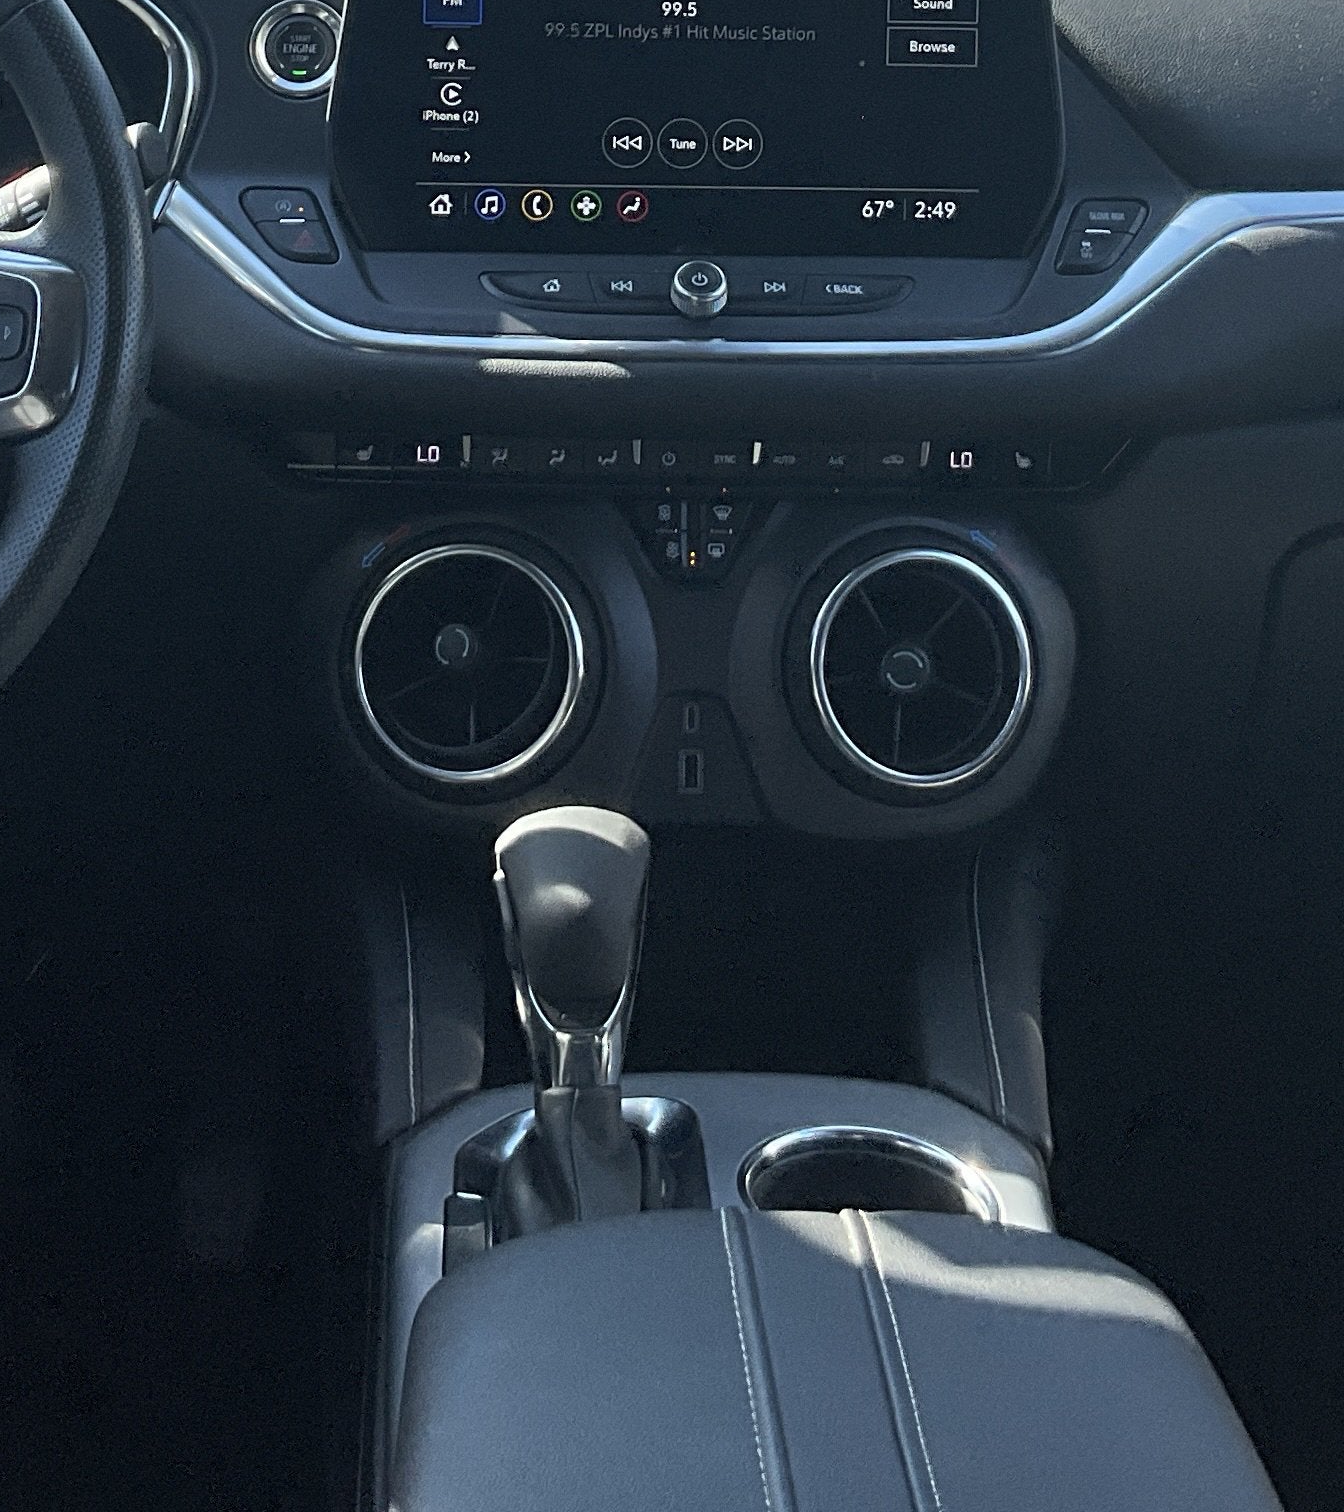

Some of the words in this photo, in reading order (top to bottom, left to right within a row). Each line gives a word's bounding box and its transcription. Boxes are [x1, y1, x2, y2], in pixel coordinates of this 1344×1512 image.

[661, 2, 698, 17] 99.5
[545, 23, 580, 38] 99.5
[584, 23, 615, 39] ZPL
[618, 24, 658, 43] Indys
[662, 25, 680, 39] #1
[687, 25, 709, 40] Hit
[713, 25, 758, 41] Music
[762, 25, 816, 41] Station
[909, 40, 956, 53] Browse
[427, 59, 455, 72] Terry
[422, 110, 460, 123] iPhone
[462, 110, 479, 124] (2)
[670, 138, 697, 150] Tune
[432, 152, 460, 163] More
[862, 199, 894, 219] 67°
[915, 201, 956, 219] 2:49
[833, 284, 863, 295] BACK
[416, 445, 440, 463] LO
[949, 451, 973, 469] LO
